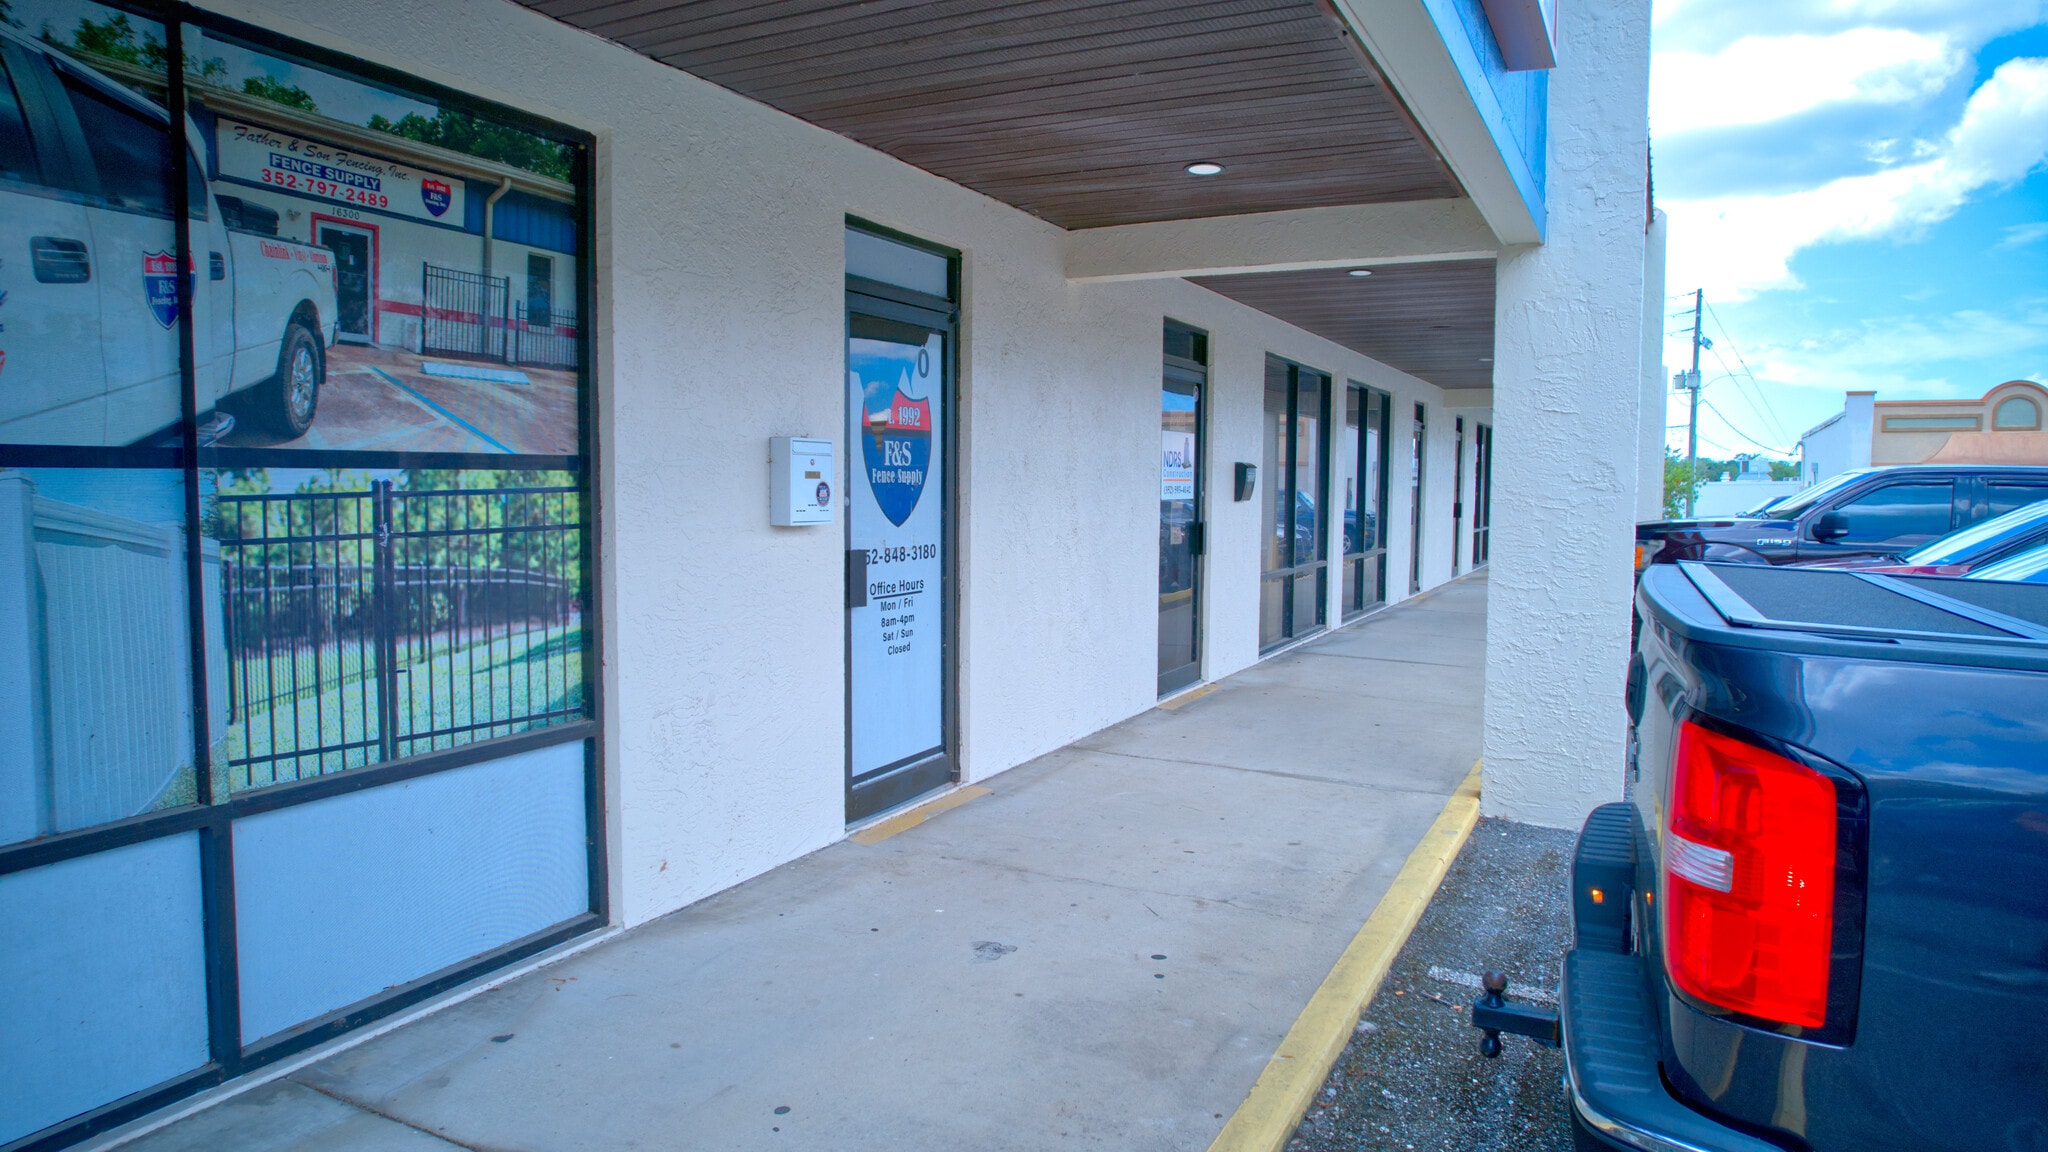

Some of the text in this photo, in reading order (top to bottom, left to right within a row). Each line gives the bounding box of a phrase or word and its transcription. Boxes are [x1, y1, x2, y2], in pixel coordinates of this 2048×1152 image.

[234, 126, 282, 149] Father
[288, 139, 299, 152] &
[303, 145, 331, 161] Son
[389, 165, 410, 181] Inc.
[271, 154, 380, 190] FENCE SUPPLY
[261, 168, 389, 208] 352-797-2489
[332, 207, 360, 221] 16300
[898, 406, 921, 426] 1992
[884, 440, 912, 467] F&S
[1163, 451, 1182, 468] NDRS
[872, 468, 923, 485] Fence Supply
[866, 543, 936, 566] 52-848-3180
[869, 579, 924, 596] Office Hours
[880, 601, 896, 612] Mon
[904, 597, 914, 608] Fri
[881, 613, 915, 628] 8am-4pm
[882, 631, 894, 642] Sat
[901, 628, 913, 638] Sun
[887, 641, 911, 656] Closed
